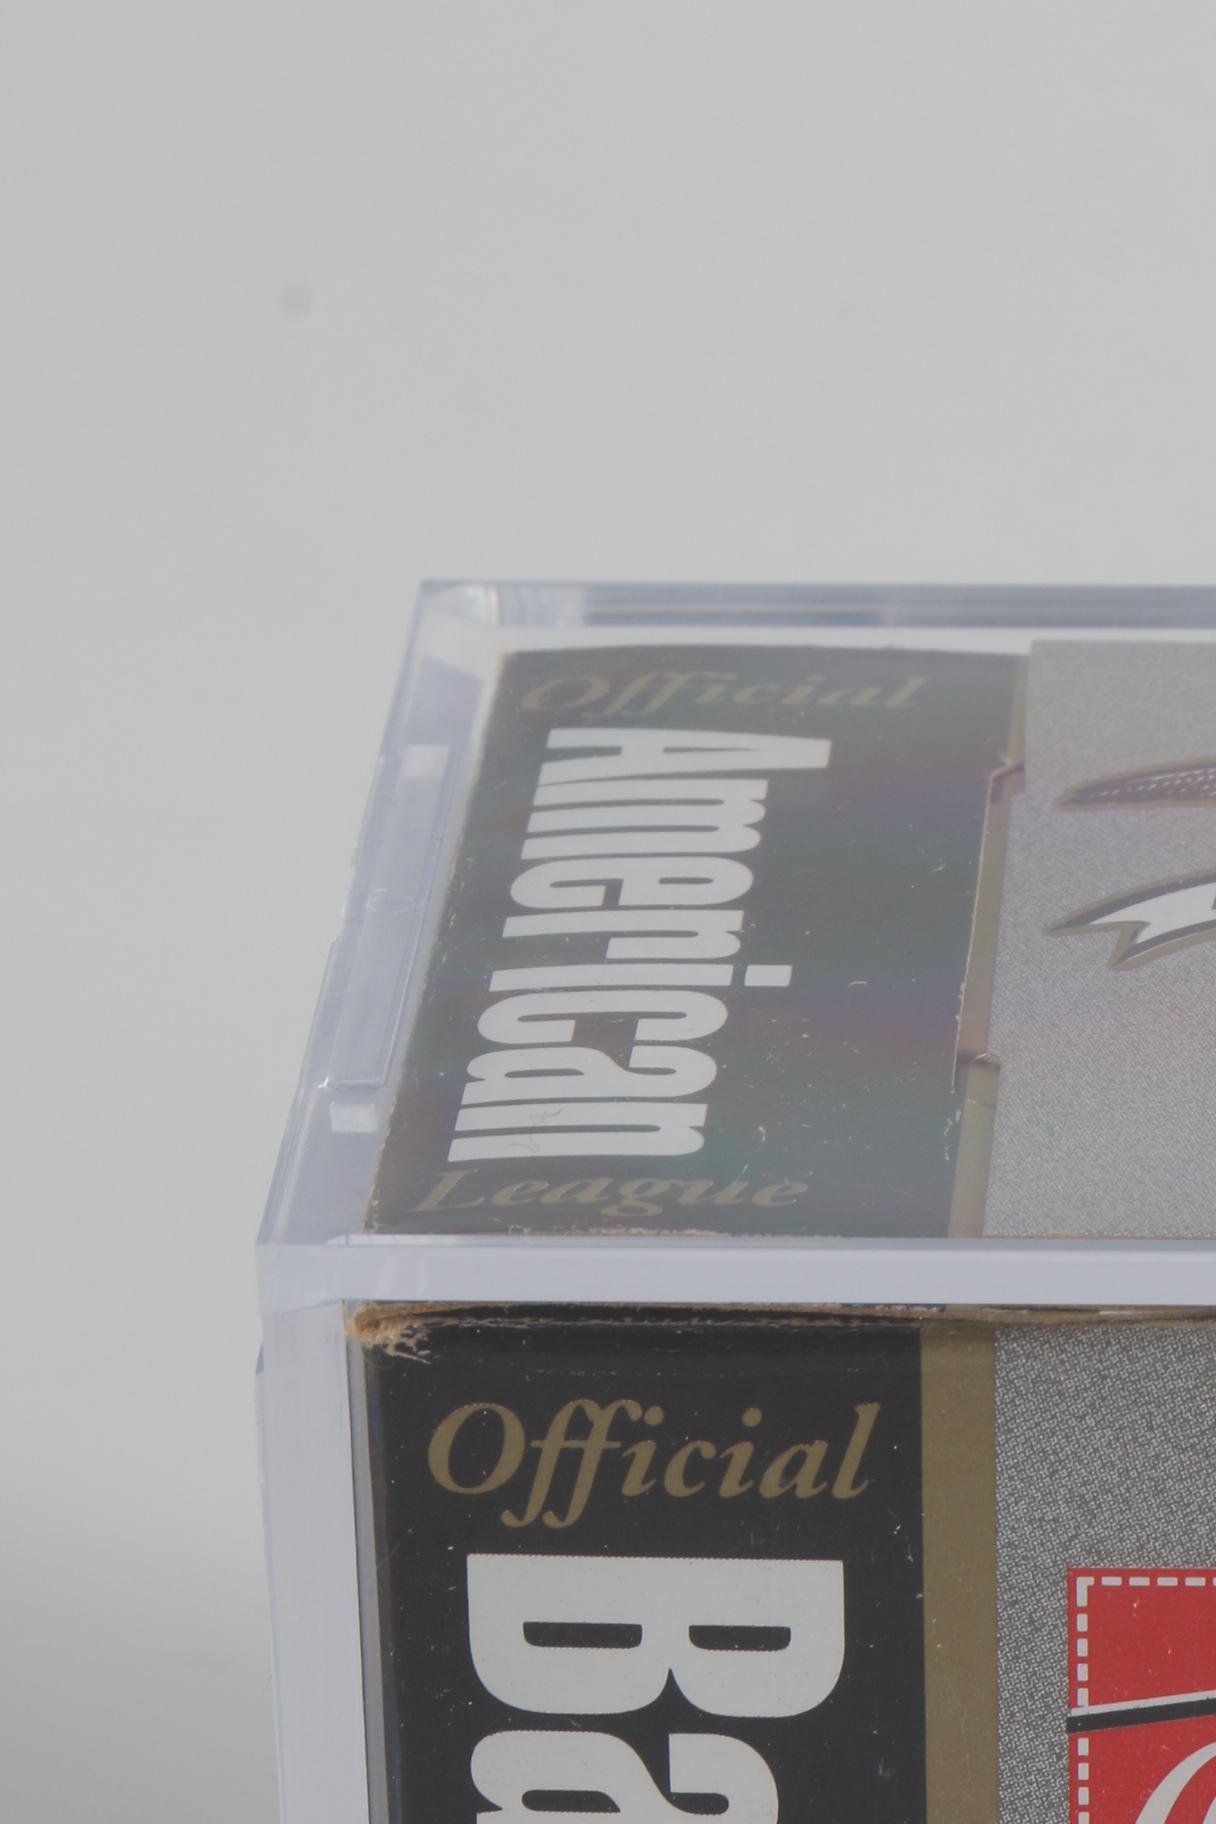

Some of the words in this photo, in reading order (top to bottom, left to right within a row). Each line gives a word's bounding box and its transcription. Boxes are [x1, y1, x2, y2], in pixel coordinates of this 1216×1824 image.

[520, 671, 930, 717] Official
[447, 726, 832, 1162] American
[411, 1169, 810, 1217] League
[427, 1398, 882, 1529] Official
